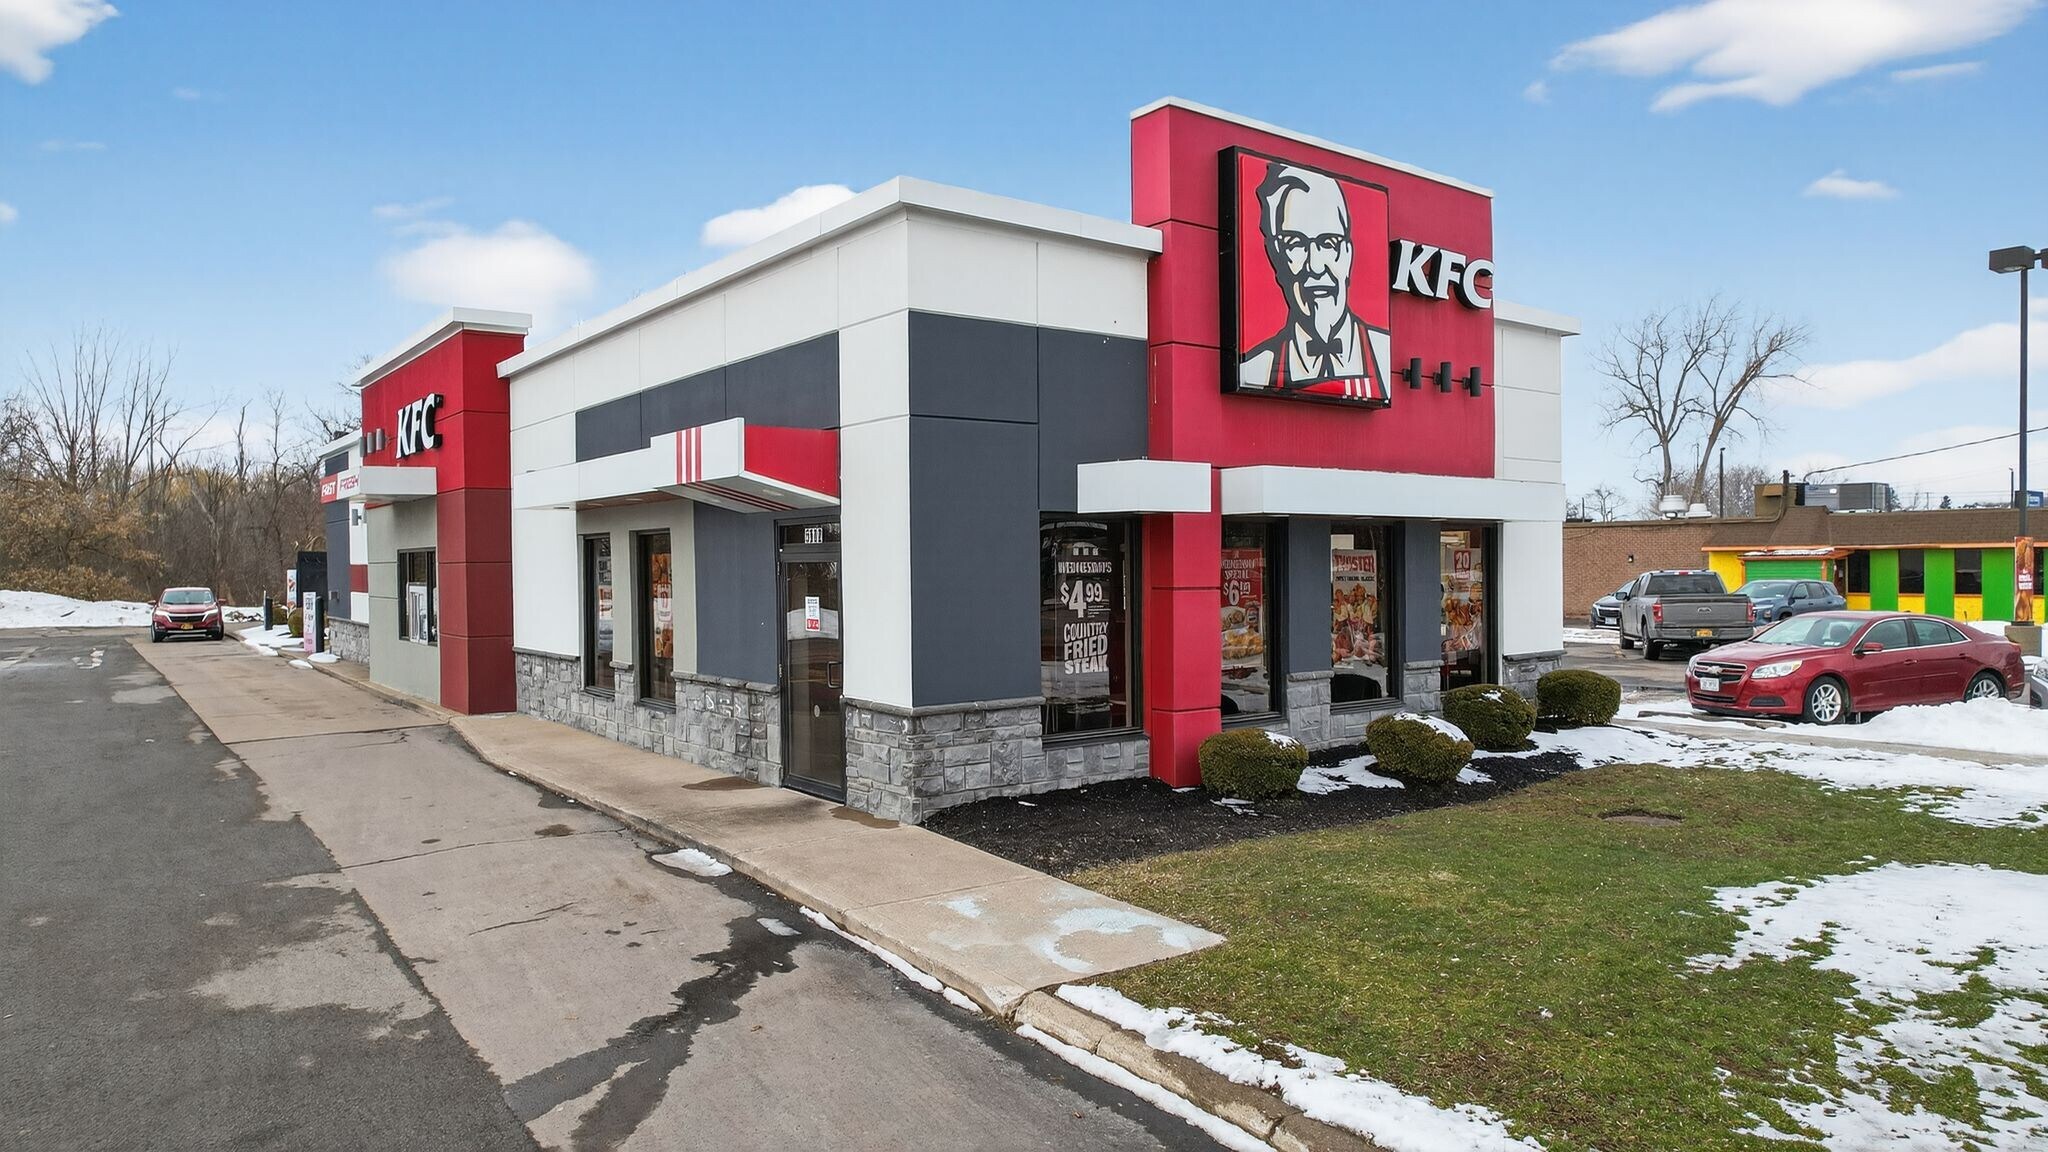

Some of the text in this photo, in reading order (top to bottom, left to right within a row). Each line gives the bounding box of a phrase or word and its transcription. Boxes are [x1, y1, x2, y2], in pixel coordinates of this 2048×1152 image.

[1391, 239, 1494, 310] KFC
[396, 393, 438, 459] KFC
[1063, 622, 1109, 643] COUNTRY
[1064, 635, 1108, 661] FRIED
[1064, 655, 1109, 675] STEAK
